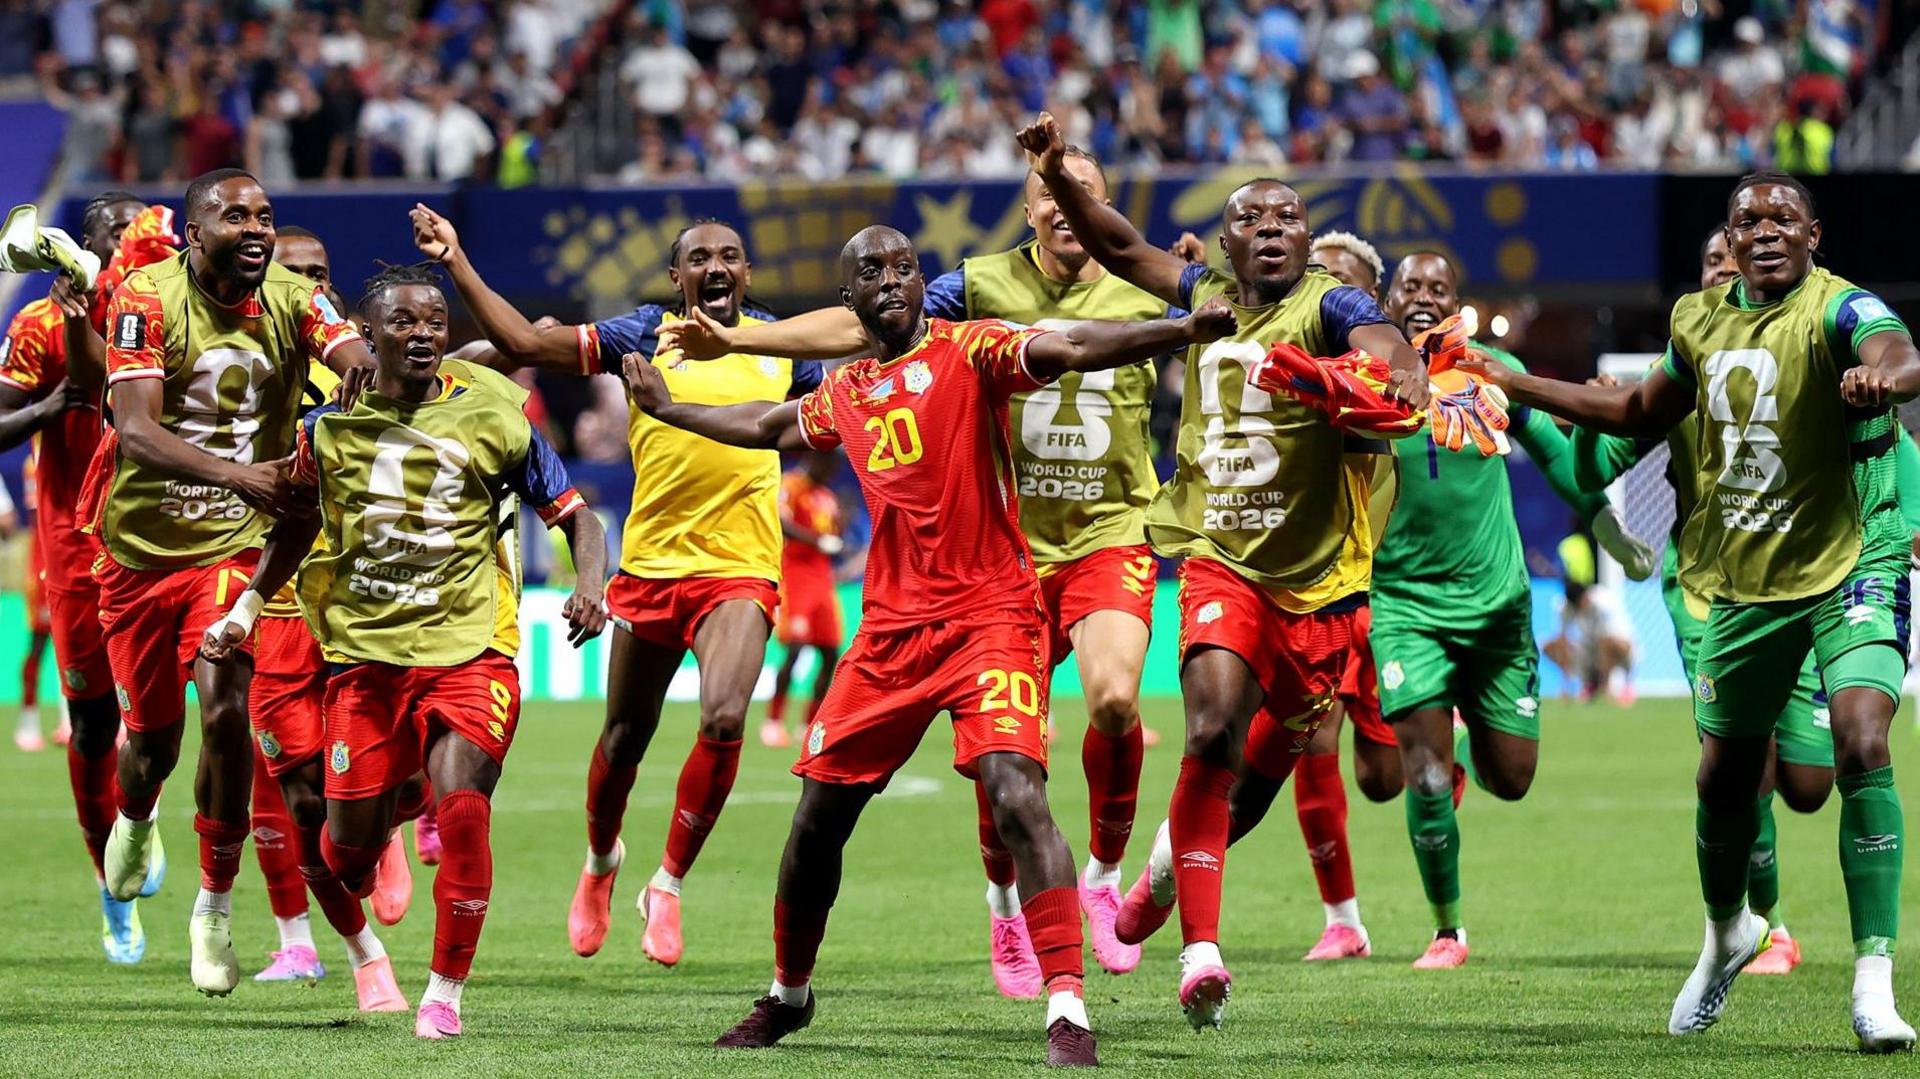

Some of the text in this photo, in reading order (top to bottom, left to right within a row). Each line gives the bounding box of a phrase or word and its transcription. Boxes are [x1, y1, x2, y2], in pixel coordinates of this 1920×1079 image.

[863, 407, 923, 472] 20
[1046, 432, 1088, 448] FIFA
[1020, 461, 1108, 480] WORLD CUP
[1216, 455, 1256, 473] FIFA
[1730, 462, 1767, 481] FIFA
[164, 480, 222, 498] WORLD
[1019, 476, 1105, 502] 2026
[1205, 490, 1285, 507] WORLD CUP
[160, 497, 248, 520] 2026
[1717, 493, 1792, 511] WORLD CUP
[1202, 507, 1288, 532] 2026
[386, 536, 429, 556] FIFA
[353, 557, 446, 585] WORLD CUP
[347, 573, 441, 607] 2026
[976, 668, 1039, 717] 20
[1856, 843, 1898, 854] umbro
[1183, 861, 1219, 872] umbro
